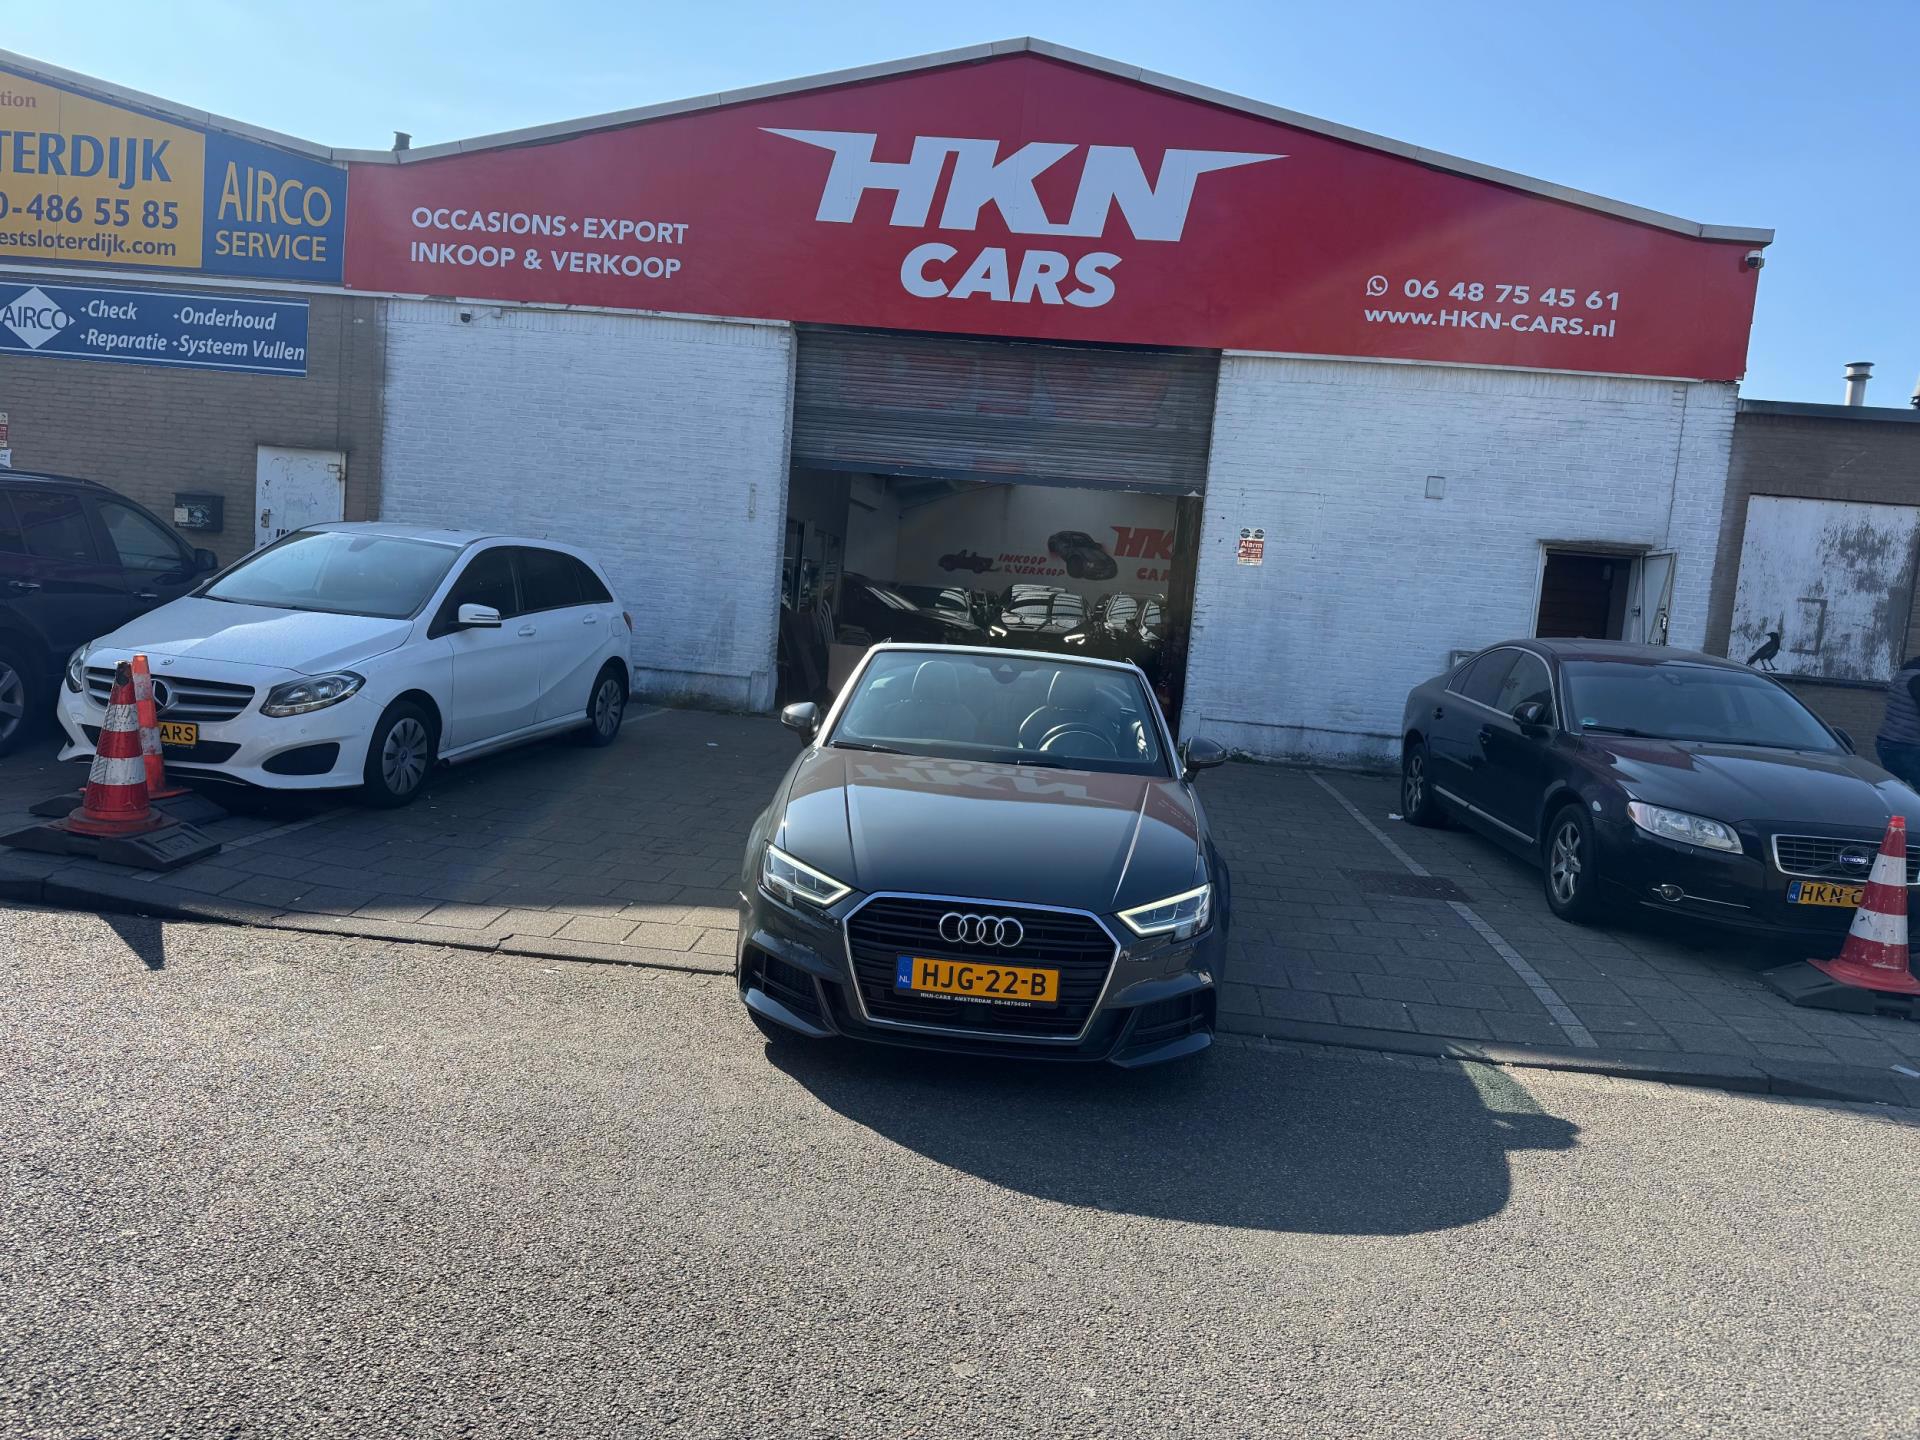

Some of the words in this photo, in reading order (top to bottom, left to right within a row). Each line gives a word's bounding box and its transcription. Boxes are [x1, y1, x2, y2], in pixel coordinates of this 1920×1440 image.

[217, 160, 332, 227] AIRCO
[756, 127, 1291, 242] HKN
[94, 198, 130, 227] 55
[142, 200, 178, 229] 85
[411, 206, 567, 237] OCCASIONS
[583, 217, 689, 244] EXPORT
[215, 229, 327, 261] SERVICE
[411, 241, 516, 267] INKOOP
[523, 248, 543, 270] &
[551, 250, 682, 279] VERKOOP
[900, 242, 1123, 308] CARS
[87, 299, 138, 320] Check
[1404, 279, 1440, 299] 06
[1448, 282, 1485, 302] 48
[1495, 284, 1531, 305] 75
[1539, 287, 1577, 308] 45
[1585, 290, 1620, 311] 61
[2, 305, 70, 331] AIRCO
[180, 306, 277, 331] Onderhoud
[1364, 309, 1616, 338] www.HKN-CARS.nl
[86, 328, 167, 351] Reparatie
[179, 335, 248, 357] Systeem
[253, 340, 305, 361] Vullen
[1240, 540, 1263, 549] Alarm
[160, 724, 194, 742] ARS
[1801, 885, 1864, 905] HKN-C
[898, 974, 911, 984] NL
[922, 962, 1047, 997] HJG-22-B
